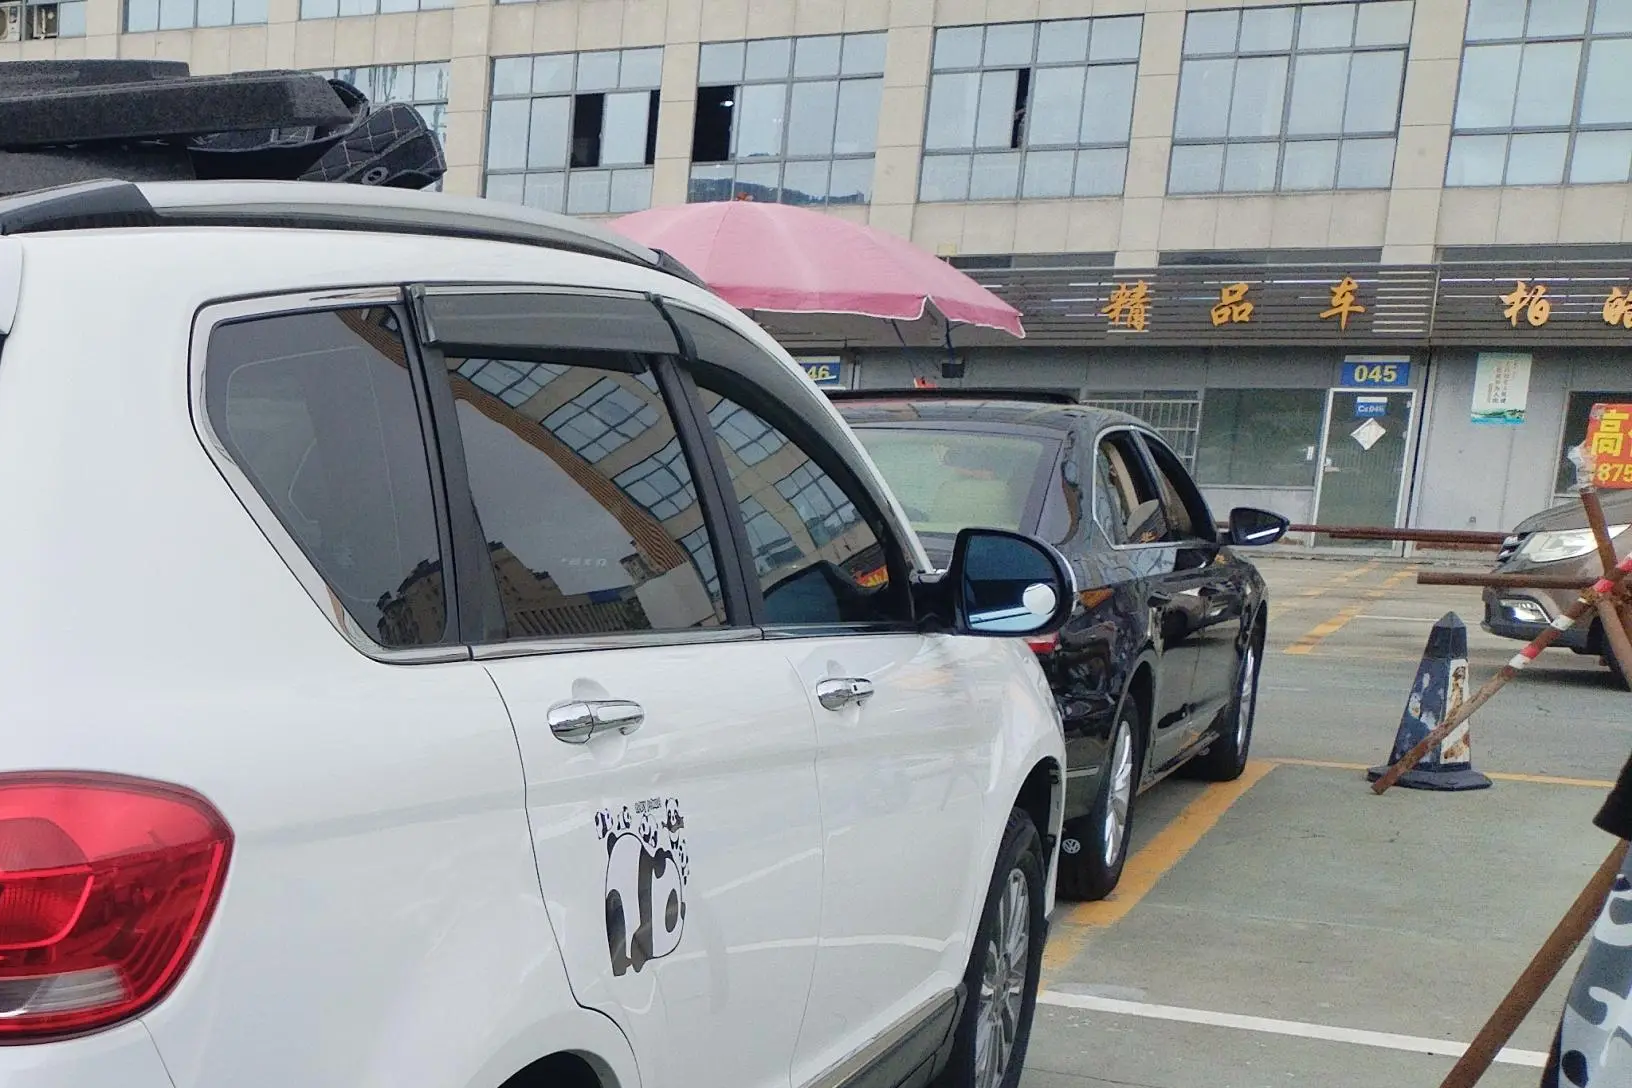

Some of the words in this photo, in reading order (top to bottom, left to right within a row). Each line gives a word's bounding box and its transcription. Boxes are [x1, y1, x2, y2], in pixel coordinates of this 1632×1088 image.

[1101, 276, 1366, 331] 精品车
[808, 365, 830, 380] 46
[1354, 364, 1398, 383] 045
[1590, 409, 1632, 457] 高
